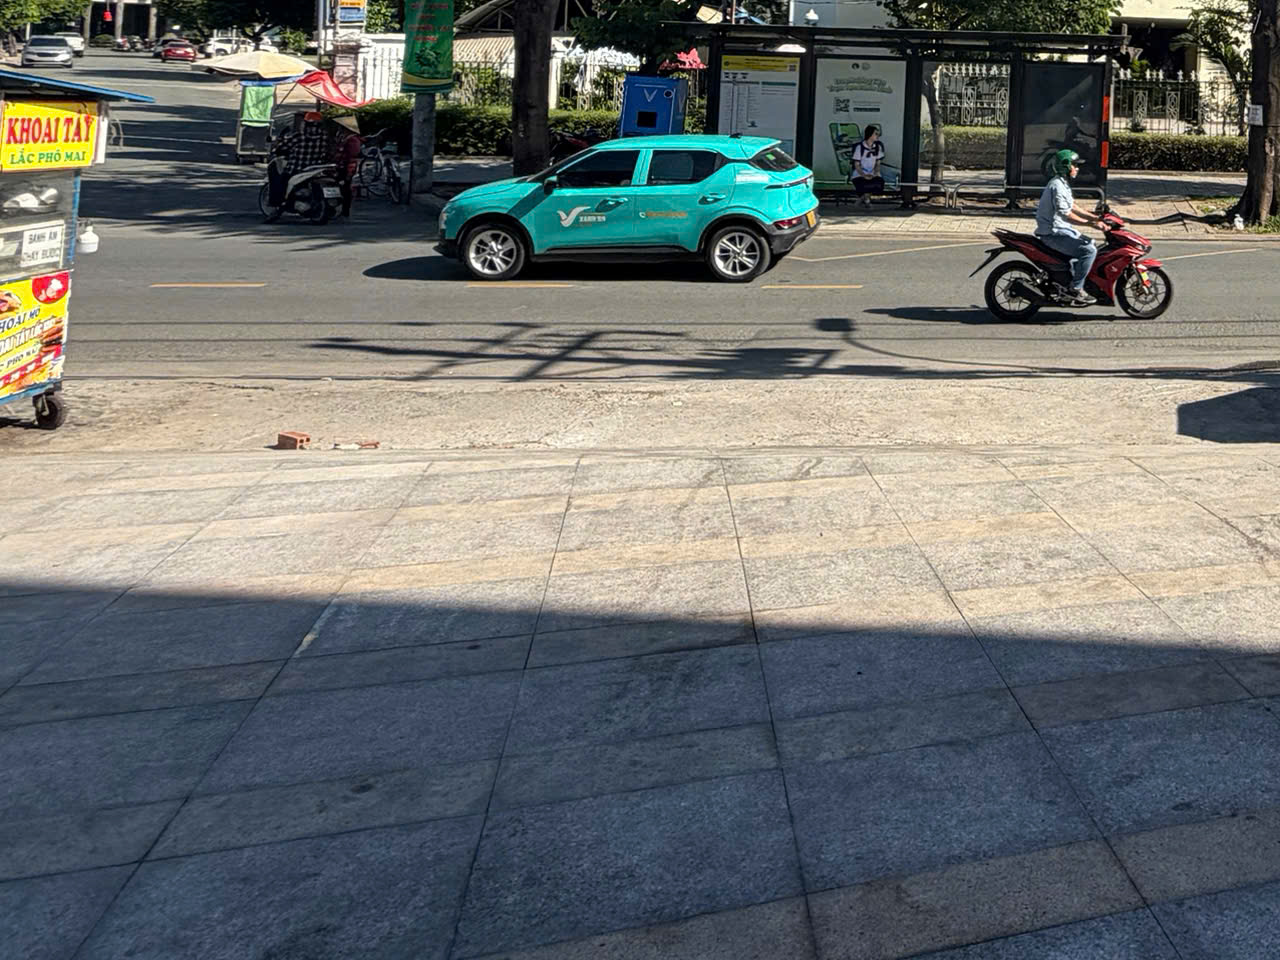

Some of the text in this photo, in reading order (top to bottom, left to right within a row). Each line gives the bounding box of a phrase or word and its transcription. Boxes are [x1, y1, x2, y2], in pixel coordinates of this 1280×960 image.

[6, 111, 93, 144] KHOAI TÂY
[10, 148, 34, 164] LẮC
[64, 151, 86, 162] MAI
